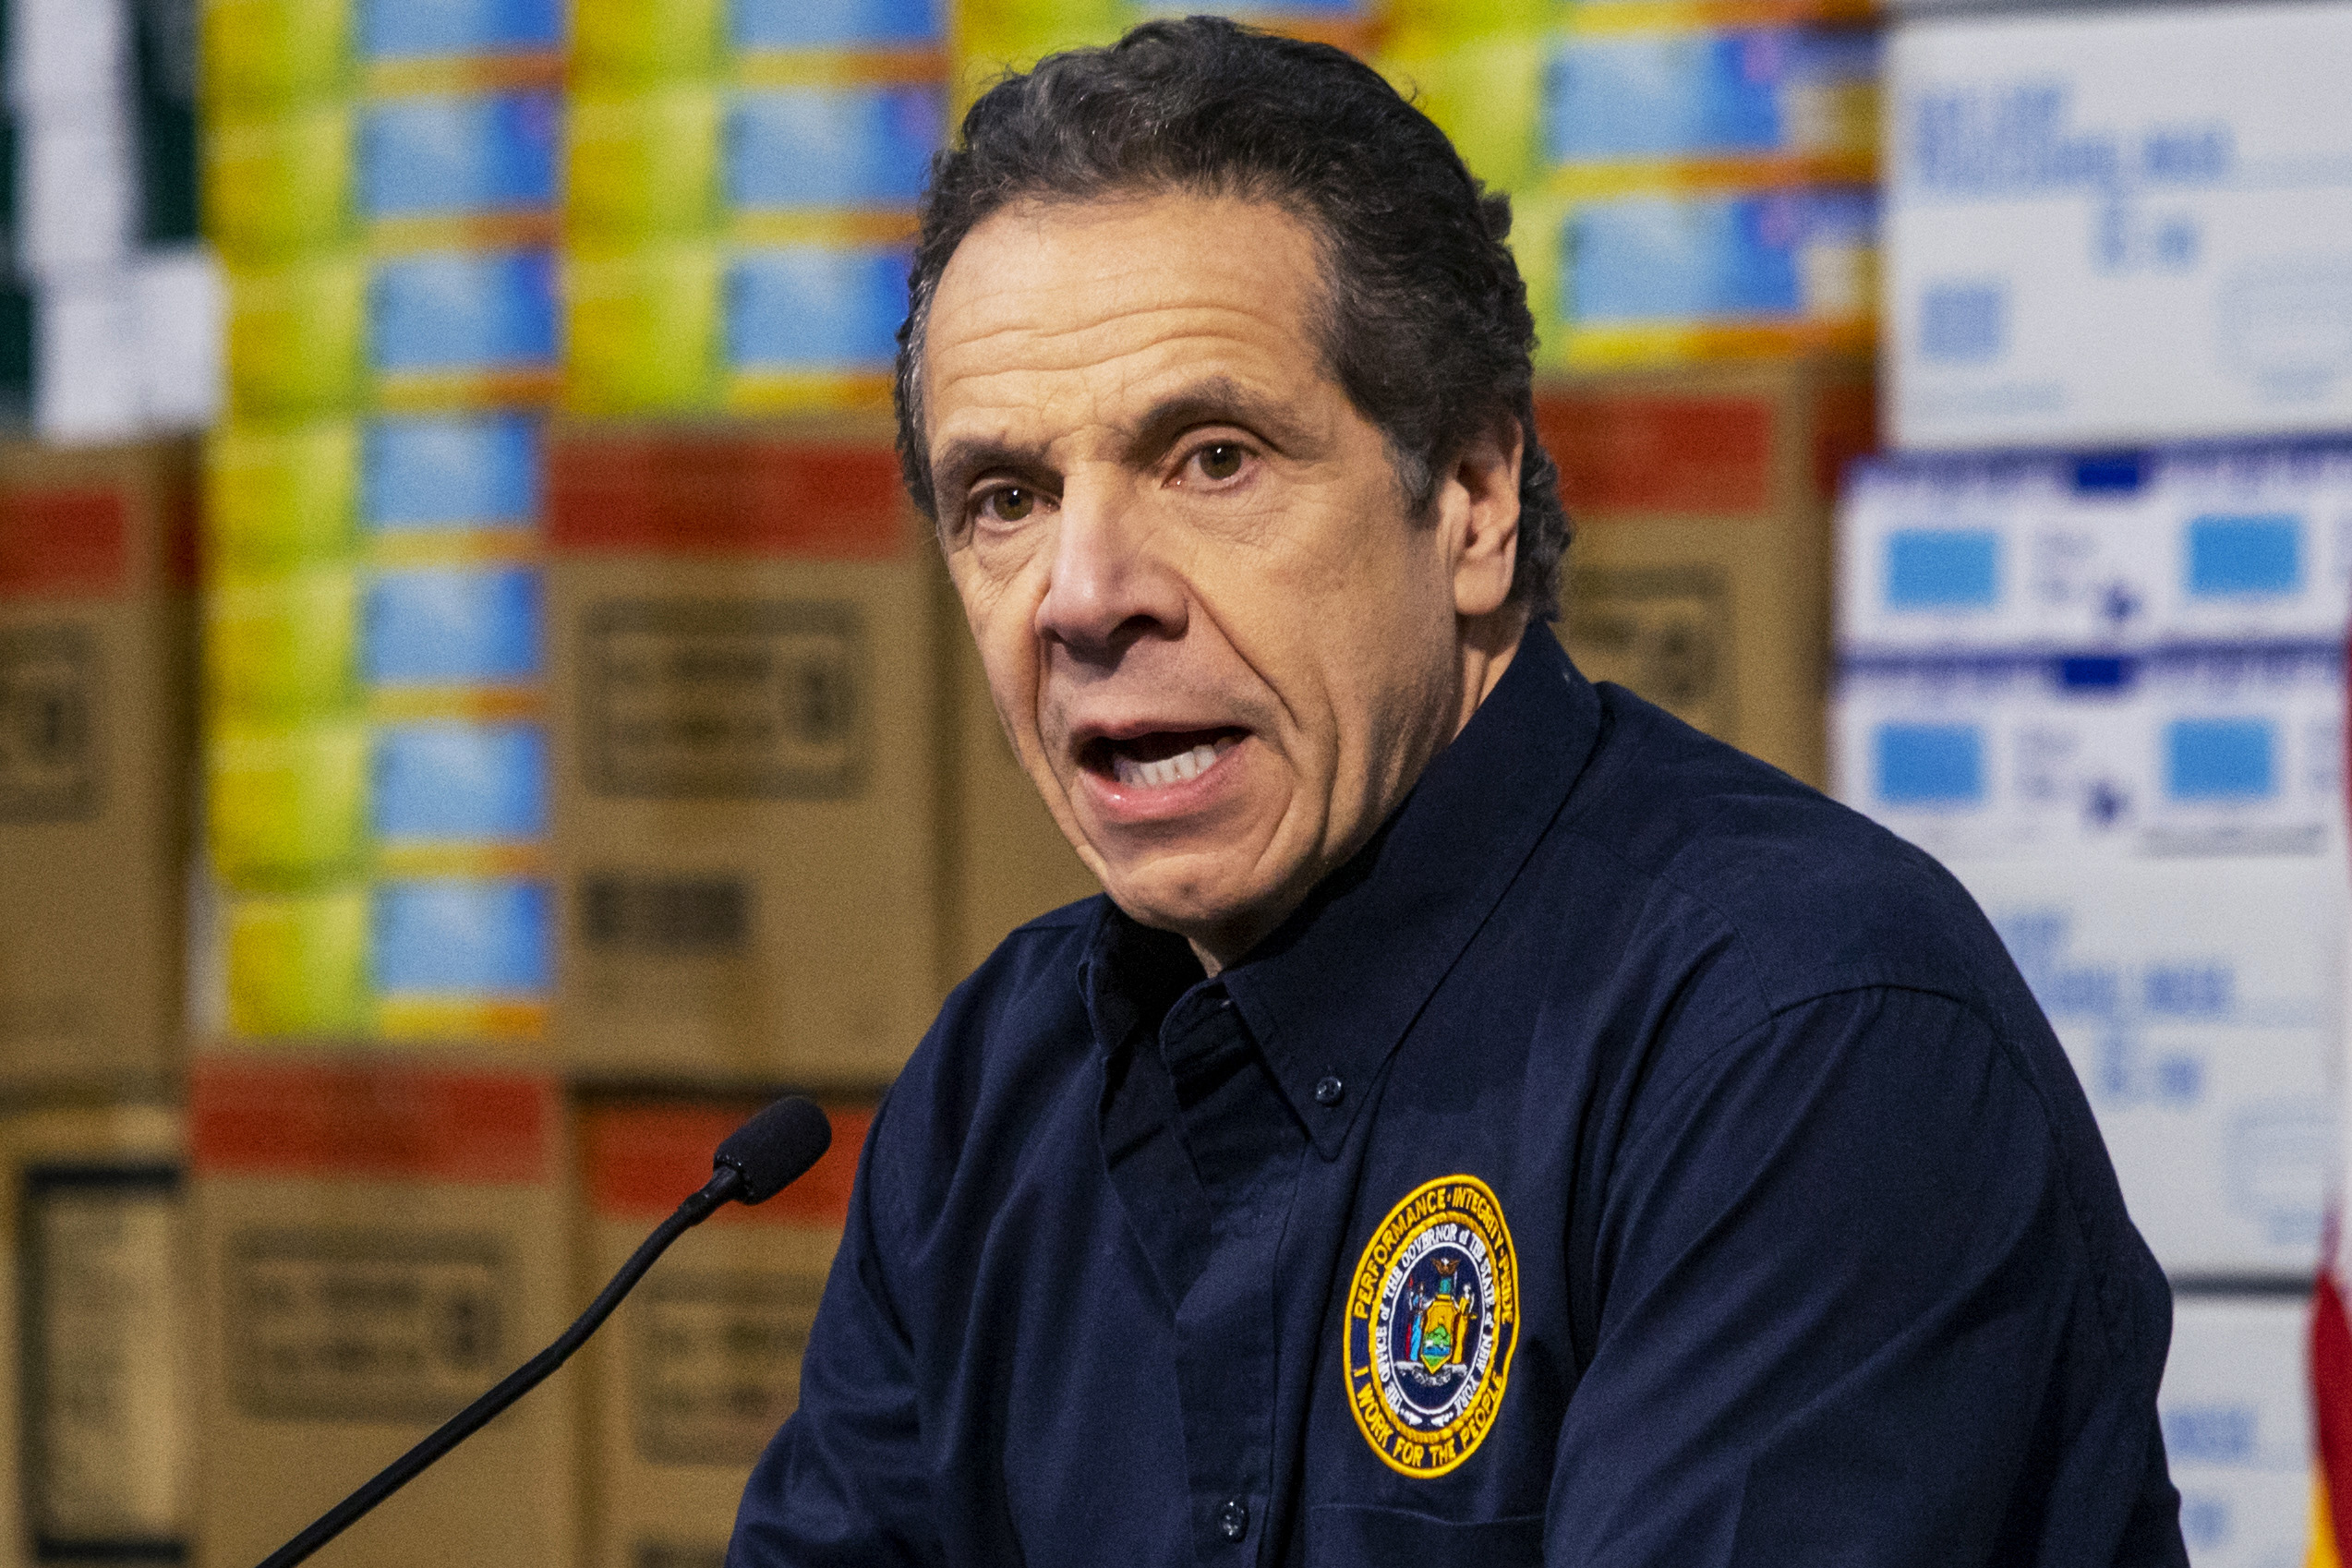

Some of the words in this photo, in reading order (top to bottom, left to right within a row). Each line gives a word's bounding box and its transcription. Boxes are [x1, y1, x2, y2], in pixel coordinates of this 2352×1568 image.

[1354, 1188, 1446, 1319] PERFORMANCE
[1452, 1187, 1504, 1250] INTEGRITY
[1383, 1266, 1403, 1298] THE
[1476, 1333, 1493, 1375] NEW
[1353, 1367, 1369, 1378] I
[1357, 1381, 1393, 1448] WORK
[1460, 1370, 1503, 1450] PEOPLE
[1393, 1436, 1424, 1467] FOR
[1429, 1438, 1456, 1466] THE
